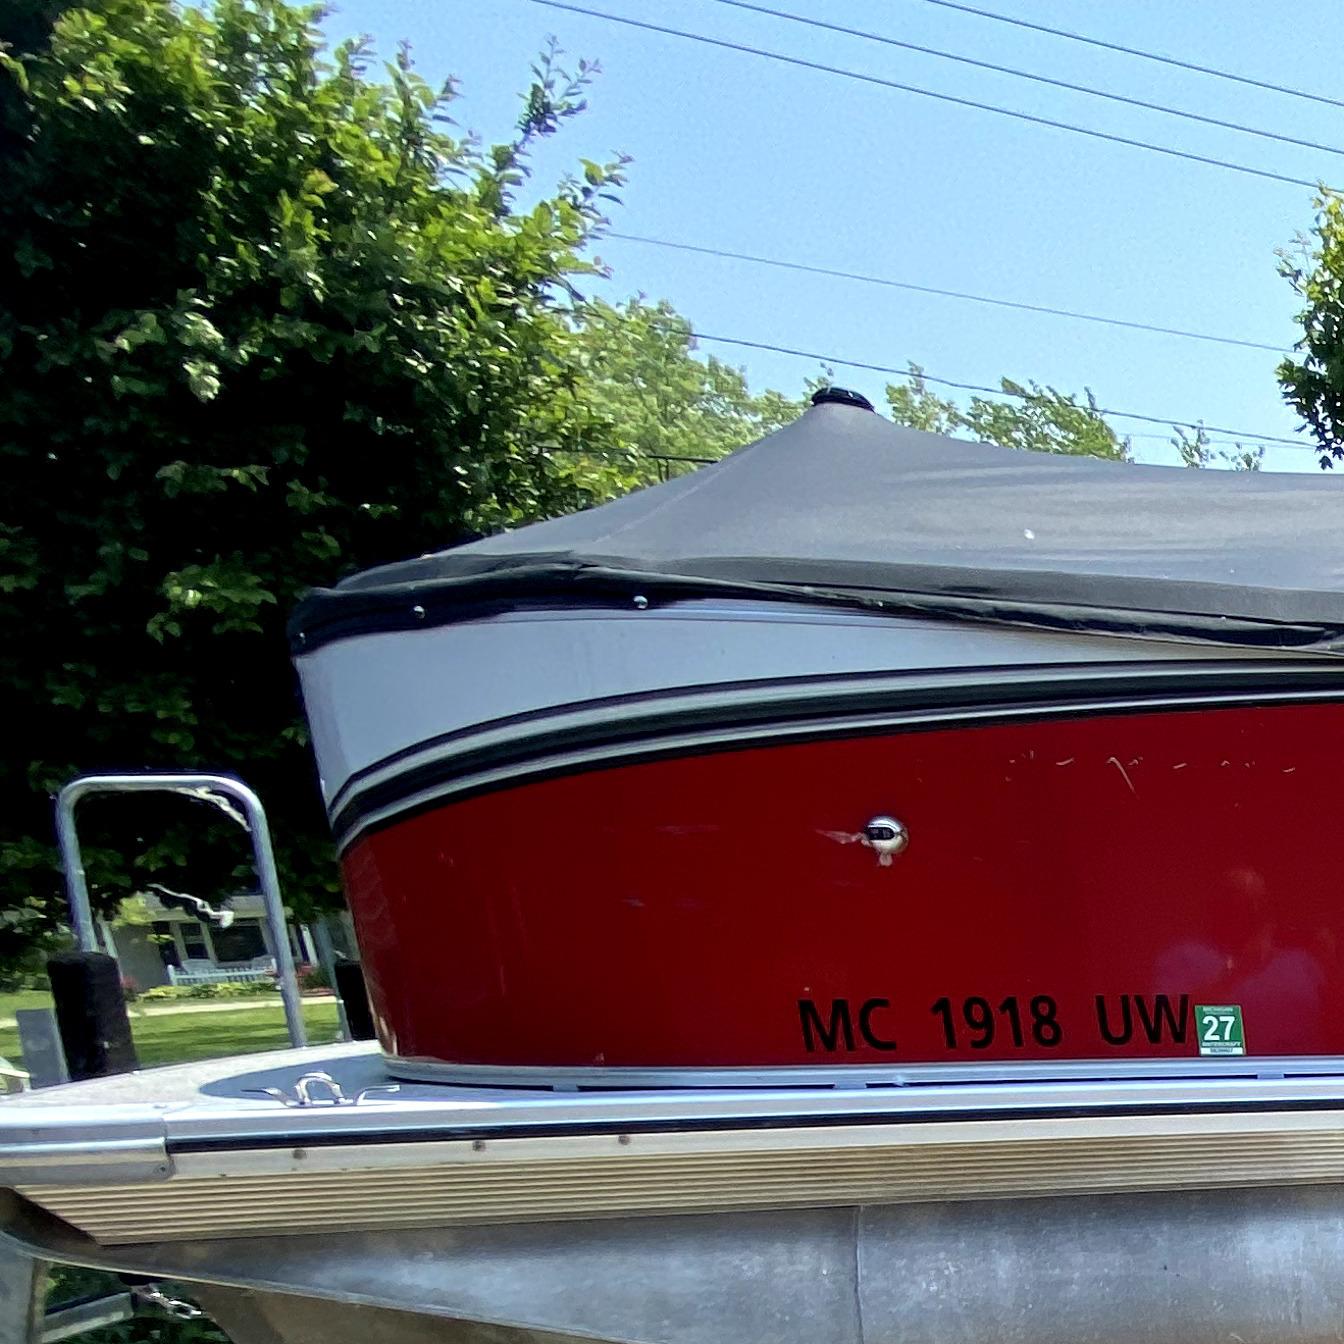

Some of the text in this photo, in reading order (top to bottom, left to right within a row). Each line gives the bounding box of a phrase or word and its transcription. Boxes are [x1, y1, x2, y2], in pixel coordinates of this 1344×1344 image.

[797, 993, 1189, 1052] MC 1918 UW
[1202, 1015, 1236, 1041] 27
